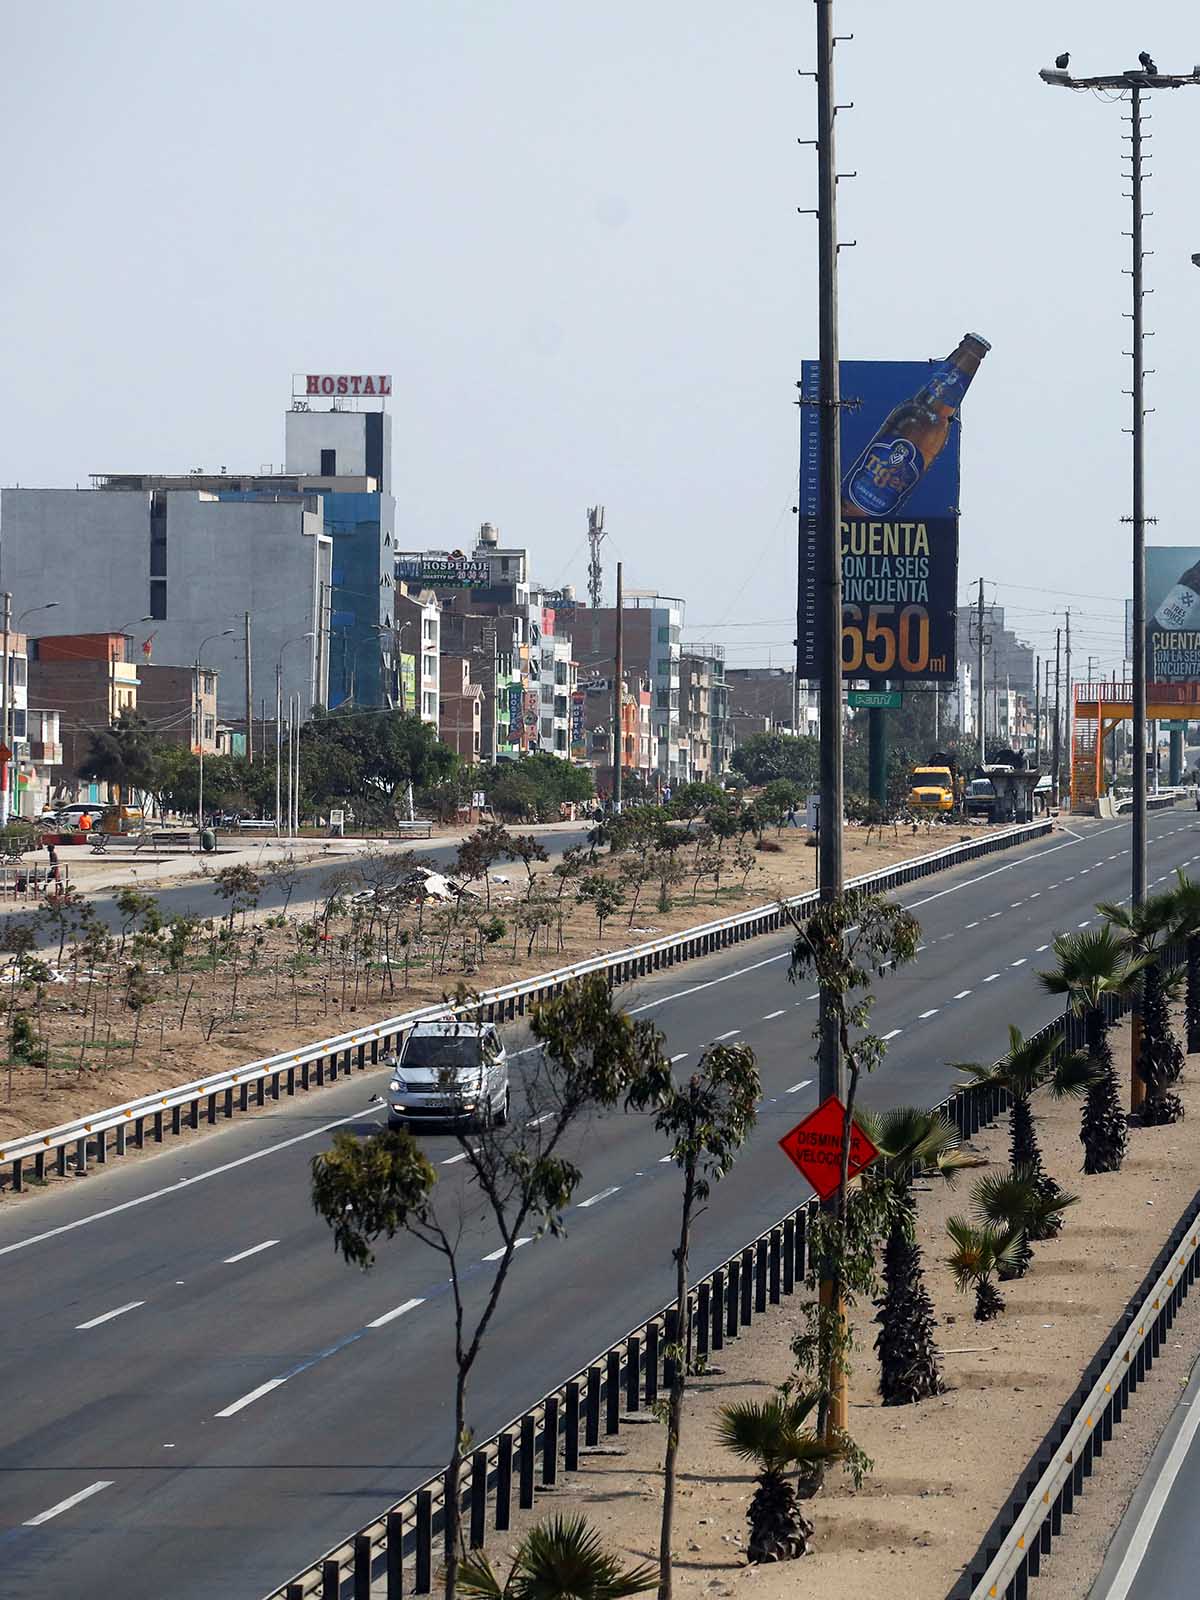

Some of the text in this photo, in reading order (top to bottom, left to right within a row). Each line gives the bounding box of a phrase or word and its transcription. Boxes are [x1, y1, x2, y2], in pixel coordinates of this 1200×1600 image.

[306, 376, 390, 394] HOSTAL
[808, 432, 818, 471] EXCESO
[423, 561, 489, 571] HOSPEDAJE
[872, 557, 892, 578] LA
[895, 556, 929, 579] SEIS
[806, 577, 816, 624] BEBIDAS
[805, 631, 815, 665] TOMAR
[841, 603, 946, 673] 650 ml
[1171, 650, 1183, 662] LA
